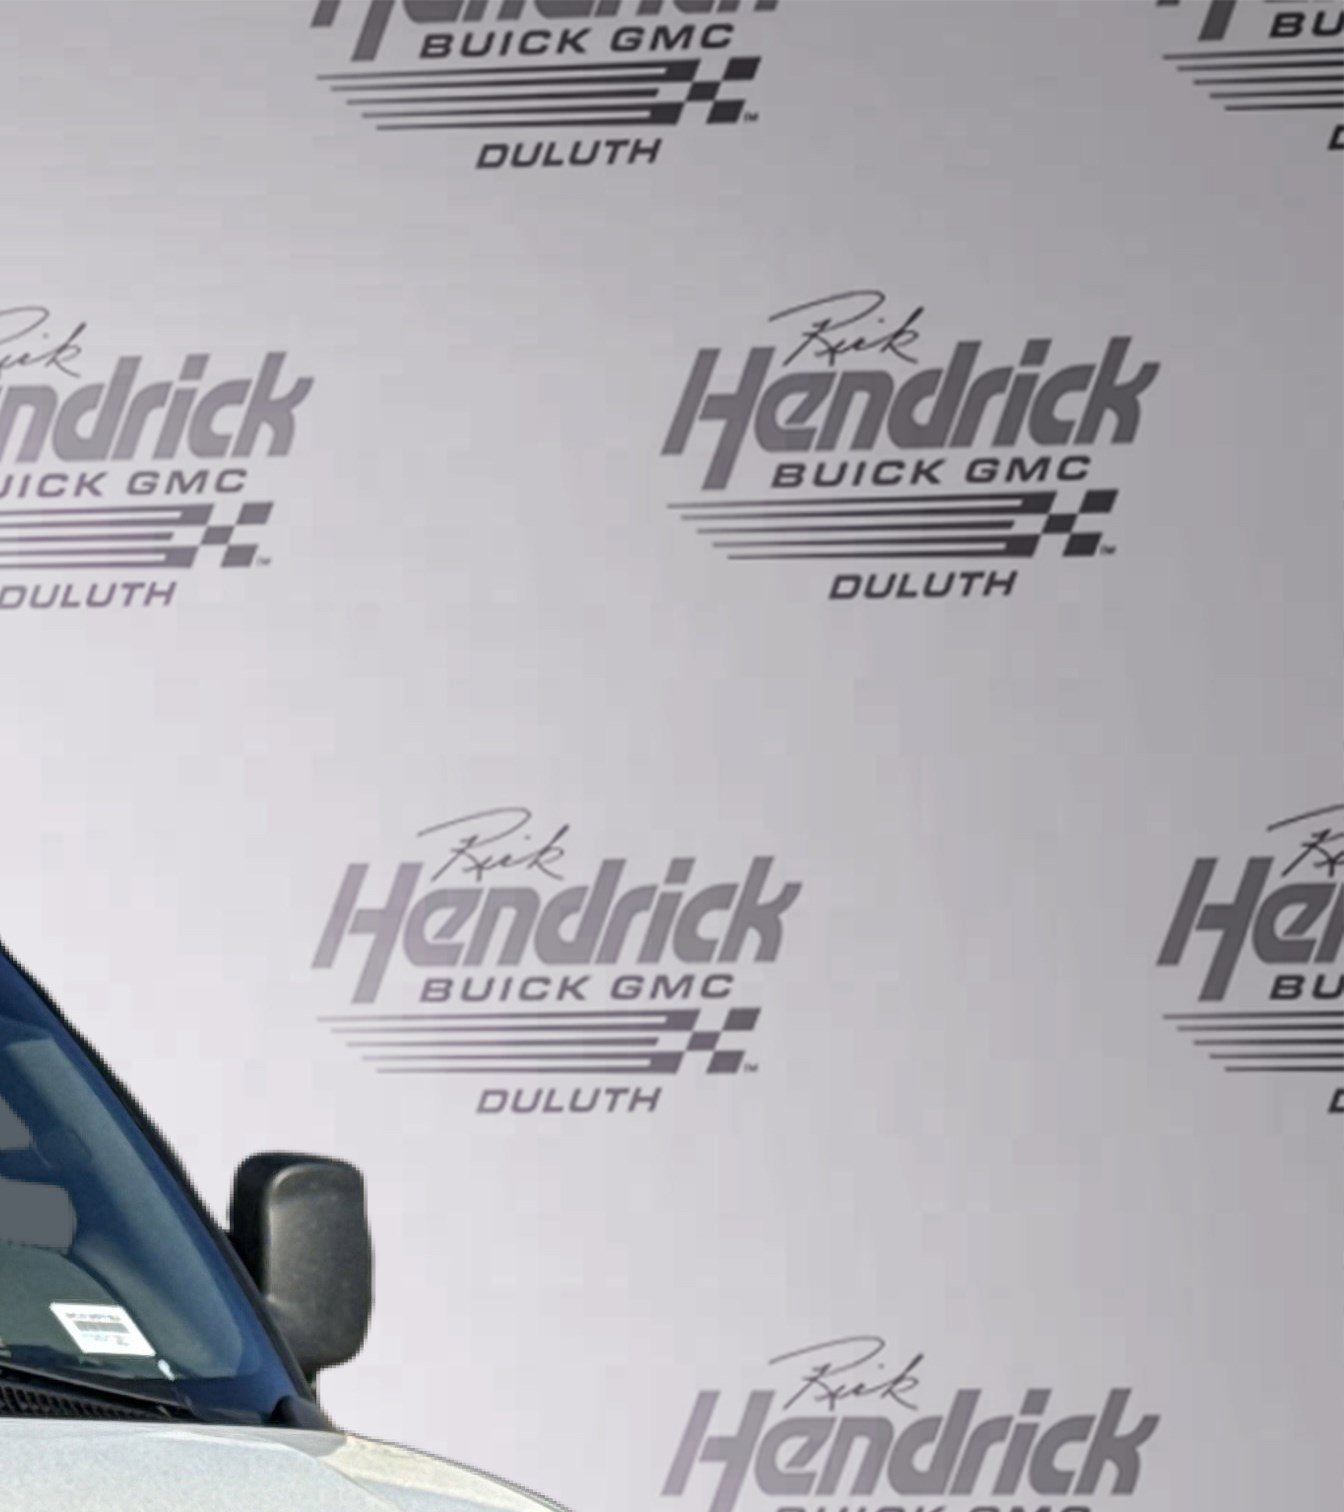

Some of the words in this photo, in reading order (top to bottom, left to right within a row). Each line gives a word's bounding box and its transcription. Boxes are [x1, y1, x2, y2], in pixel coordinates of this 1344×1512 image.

[419, 28, 591, 59] BUICK
[611, 23, 735, 52] GMC
[475, 138, 662, 168] DULUTH
[660, 336, 1161, 490] Hendrick
[127, 469, 248, 495] GMC
[771, 458, 946, 489] BUICK
[965, 455, 1092, 483] GMC
[828, 570, 1018, 599] DULUTH
[310, 856, 803, 1004] Hendrick
[420, 975, 591, 1002] BUICK
[611, 974, 734, 999] GMC
[476, 1088, 662, 1114] DULUTH
